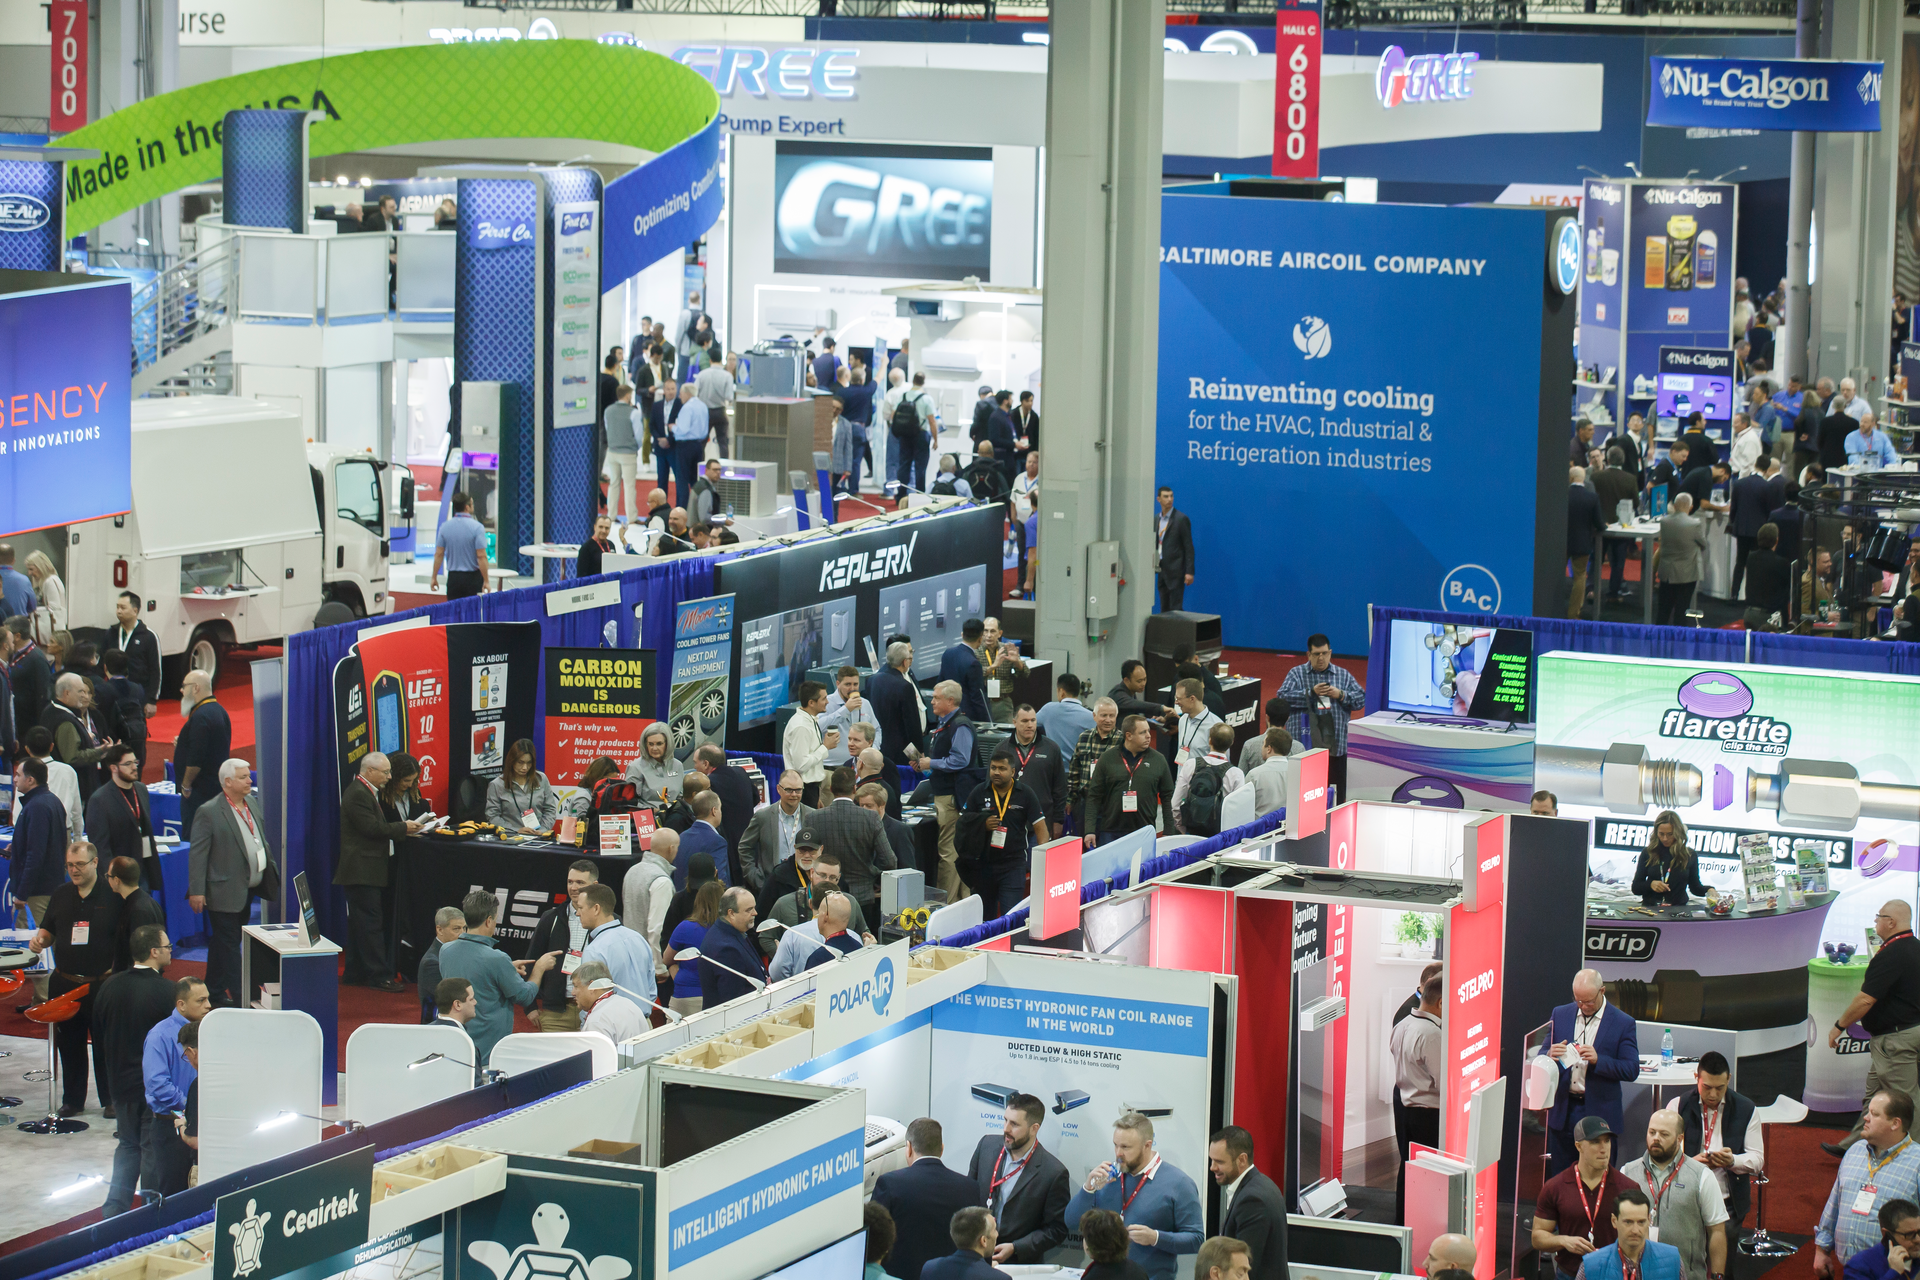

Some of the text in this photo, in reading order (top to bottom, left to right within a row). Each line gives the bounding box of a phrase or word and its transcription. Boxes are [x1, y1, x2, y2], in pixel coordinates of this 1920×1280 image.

[1283, 25, 1316, 36] HALL C
[62, 10, 77, 116] 7000
[1402, 53, 1479, 102] GREE
[1672, 66, 1829, 109] Nu-Calgon
[1286, 44, 1308, 160] 6800
[717, 115, 845, 136] Pump Expert
[66, 119, 224, 205] Made in the
[1655, 188, 1722, 208] Nu-Calgon
[634, 190, 691, 236] Optimizing
[780, 162, 988, 258] GREE
[478, 222, 534, 242] First Co.
[1279, 251, 1367, 272] AIRCOIL
[1374, 255, 1487, 276] COMPANY
[1562, 243, 1577, 270] BAC
[1668, 314, 1687, 323] USA
[1674, 352, 1728, 369] Nu-Calgon
[1188, 377, 1435, 416] Reinventing cooling
[1188, 409, 1433, 442] for the HVAC, Industrial &
[14, 426, 101, 453] INNOVATIONS
[1187, 441, 1432, 472] Refrigeration industries
[819, 530, 919, 592] KEPLERX
[1450, 581, 1492, 611] BAC
[678, 607, 716, 634] Moore
[677, 632, 730, 649] COOLING TOWER FANS
[472, 654, 509, 665] ASK ABOUT
[687, 650, 718, 663] NEXT DAY
[1492, 653, 1512, 662] Conical
[559, 659, 642, 676] CARBON
[678, 661, 726, 678] FAN SHIPMENT
[560, 676, 642, 689] MONOXIDE
[594, 690, 609, 701] IS
[562, 703, 641, 715] DANGEROUS
[420, 714, 434, 735] 10
[559, 722, 618, 734] That's why we,
[1662, 711, 1789, 744] flaretite
[574, 738, 635, 749] Make products
[574, 748, 594, 756] keep
[629, 749, 640, 757] and
[1726, 742, 1784, 755] clip the drip
[423, 766, 430, 782] 8
[1304, 787, 1324, 802] STELPRO
[639, 824, 654, 835] NEW
[1481, 855, 1501, 873] STELPRO
[1051, 880, 1077, 898] STELPRO
[1295, 904, 1319, 929] igning
[1294, 928, 1317, 950] future
[1587, 933, 1646, 955] drip
[1293, 947, 1319, 974] omfort
[1460, 969, 1494, 1004] STELPRO
[975, 994, 1022, 1011] WIDEST
[1025, 1000, 1089, 1017] HYDRONIC
[1091, 1006, 1115, 1020] FAN
[1118, 1009, 1147, 1023] COIL
[1150, 1012, 1193, 1028] RANGE
[1026, 1017, 1115, 1037] IN THE WORLD
[1008, 1042, 1123, 1062] DUCTED LOW & HIGH STATIC
[1009, 1052, 1017, 1061] Up
[1100, 1062, 1120, 1071] cooling
[841, 1071, 859, 1086] FANCOIL
[673, 1148, 860, 1251] INTELLIGENT HYDRONIC FAN COIL
[283, 1188, 359, 1238] Ceairtek
[354, 1233, 413, 1265] DEHUMIDIFICATION
